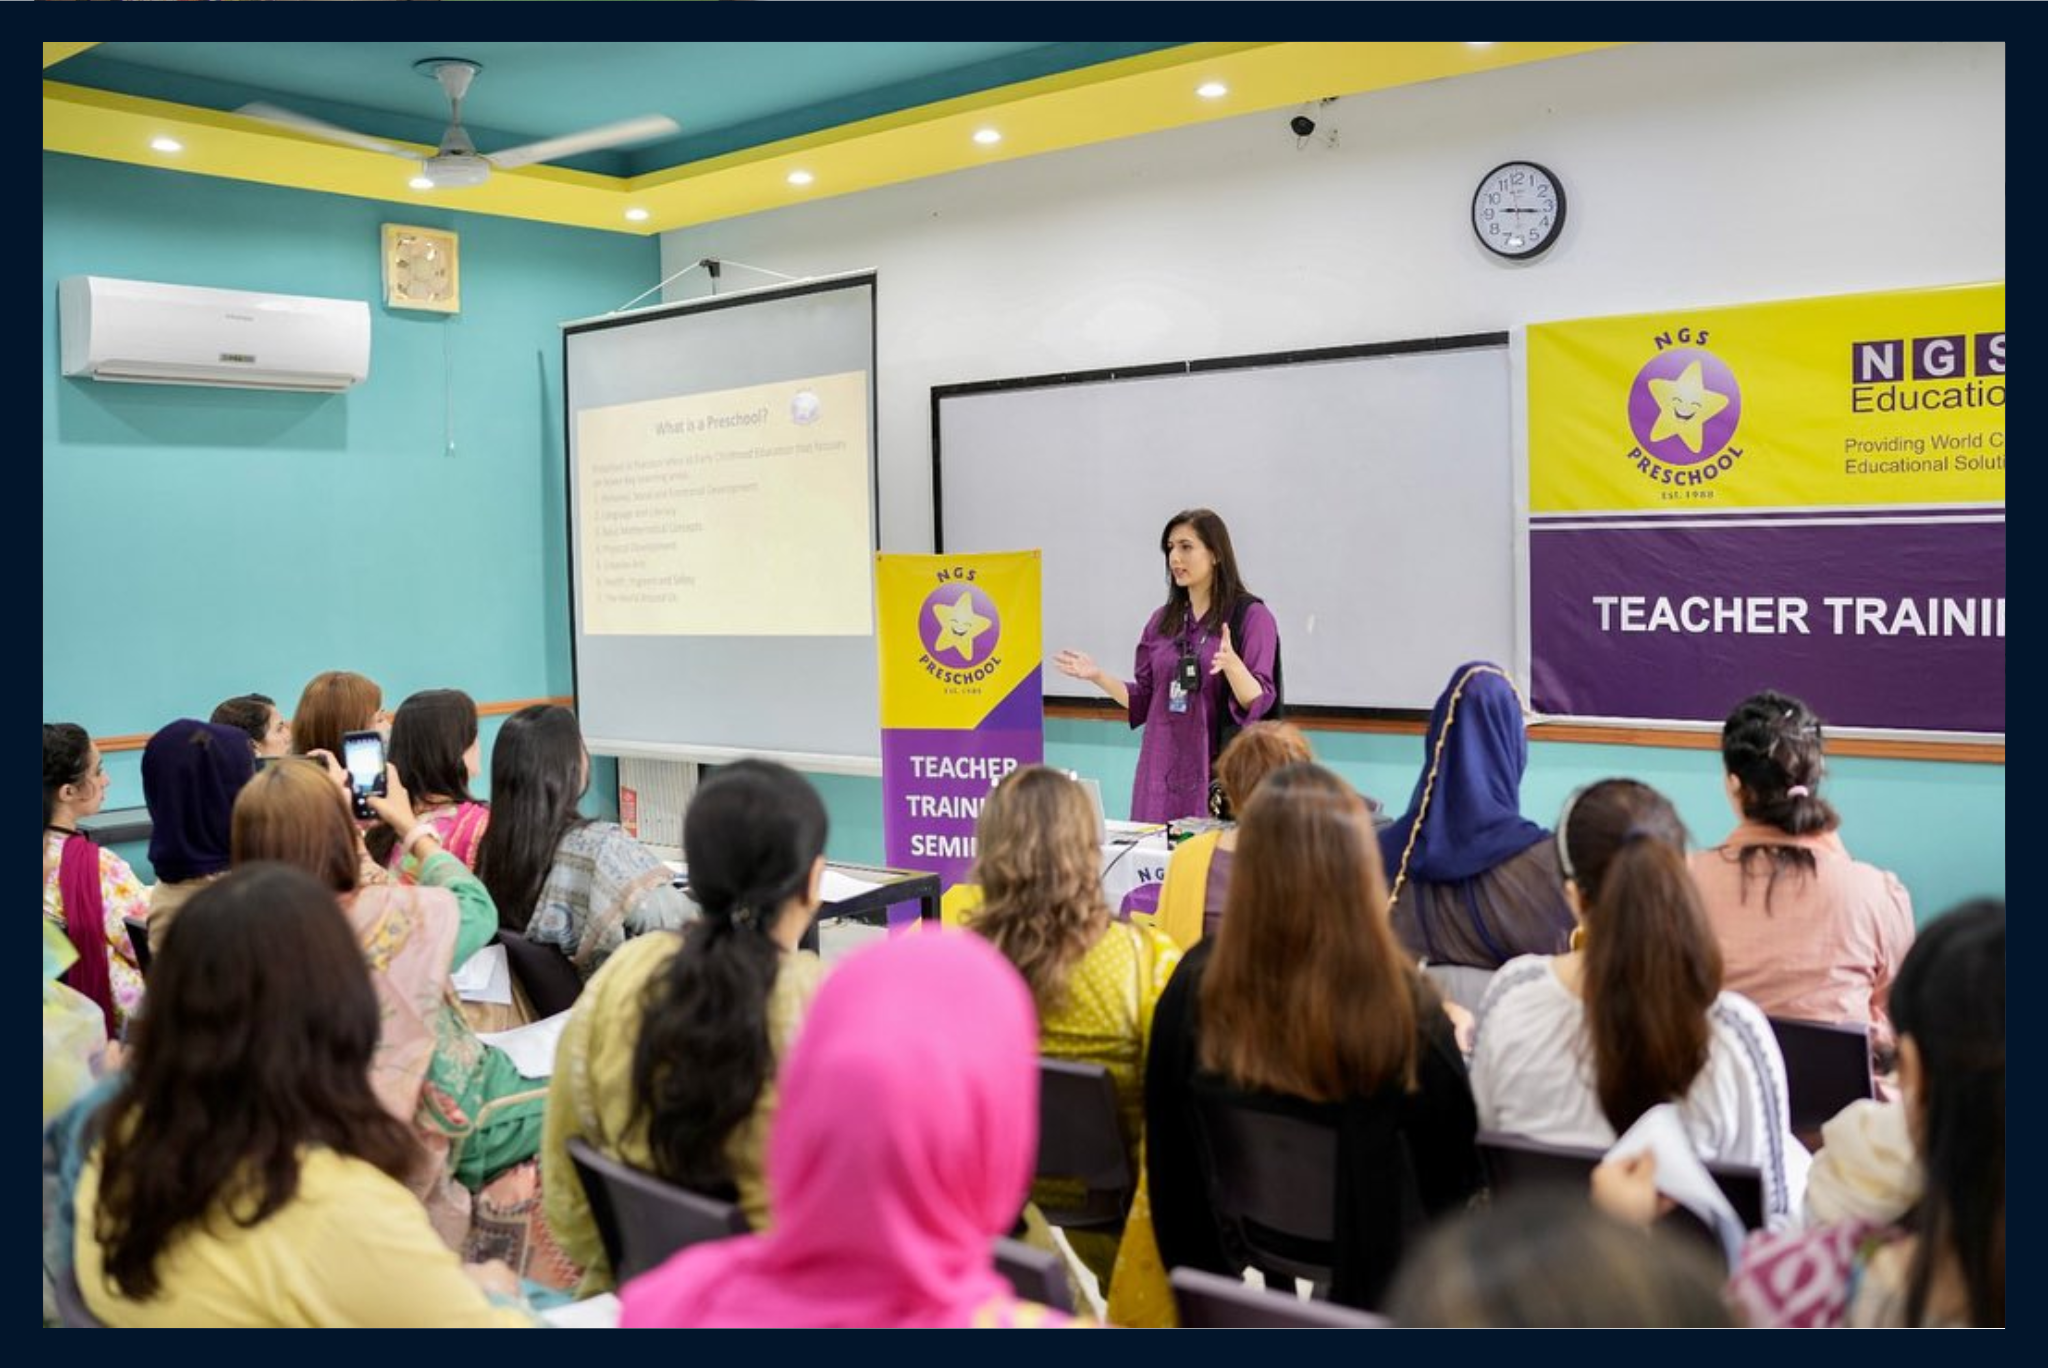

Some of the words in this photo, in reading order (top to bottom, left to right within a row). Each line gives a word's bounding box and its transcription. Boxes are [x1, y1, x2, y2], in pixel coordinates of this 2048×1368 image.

[1499, 179, 1508, 191] 11
[1510, 172, 1525, 185] 12
[1489, 192, 1501, 205] 10
[1537, 185, 1548, 198] 2
[1543, 199, 1553, 212] 3
[1484, 208, 1495, 220] 9
[1539, 215, 1549, 227] 4
[1489, 223, 1500, 235] 8
[1529, 228, 1540, 241] 5
[1502, 232, 1512, 245] 7
[1654, 328, 1709, 350] NGS
[655, 420, 684, 436] What
[706, 407, 768, 429] Preschool?
[1845, 437, 1925, 454] Providing
[1930, 432, 1982, 450] World
[1627, 447, 1743, 485] PRESCHOOL
[1845, 456, 1948, 474] Educational
[937, 567, 976, 582] NGS
[1593, 596, 1810, 634] TEACHER
[919, 654, 1001, 685] PRESCHOOL
[910, 756, 1018, 779] TEACHER
[911, 834, 977, 858] SEMI
[1137, 868, 1165, 882] NG
